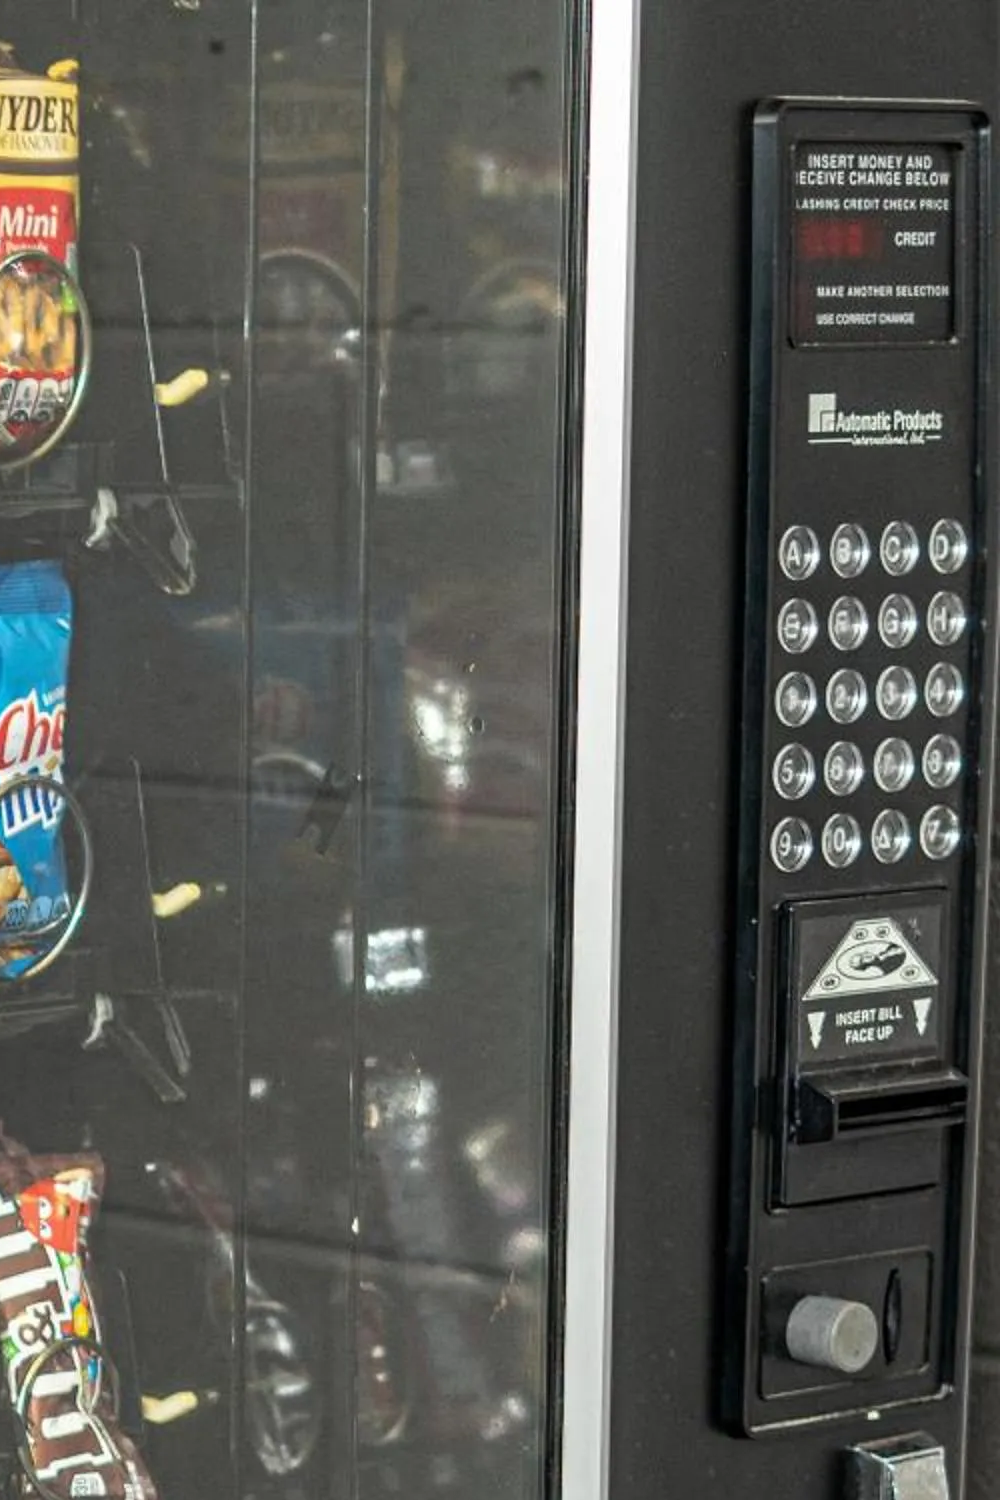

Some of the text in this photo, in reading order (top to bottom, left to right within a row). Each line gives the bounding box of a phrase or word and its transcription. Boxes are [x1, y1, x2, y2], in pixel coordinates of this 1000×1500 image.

[807, 154, 933, 170] INSERT MONEY AND
[796, 171, 949, 186] ECEIVE CHANGE BELOW
[843, 198, 880, 211] CREDIT
[882, 199, 917, 211] CHECK
[919, 199, 949, 211] PRICE
[0, 203, 60, 239] Mini
[894, 231, 937, 247] CREDIT
[816, 285, 949, 298] MAKE ANOTHER SELECTION
[816, 312, 915, 326] USE CORRECT CHANGE
[836, 409, 943, 432] Automatic Products
[787, 535, 949, 566] A B C D
[884, 608, 899, 634] G
[933, 607, 947, 632] H
[834, 684, 846, 709] 2
[931, 678, 945, 702] 4
[782, 759, 793, 784] 5
[831, 756, 844, 781] 6
[928, 750, 942, 774] 8
[780, 831, 791, 856] 9
[835, 1005, 904, 1027] INSERT BILL
[845, 1025, 894, 1045] FACE UP
